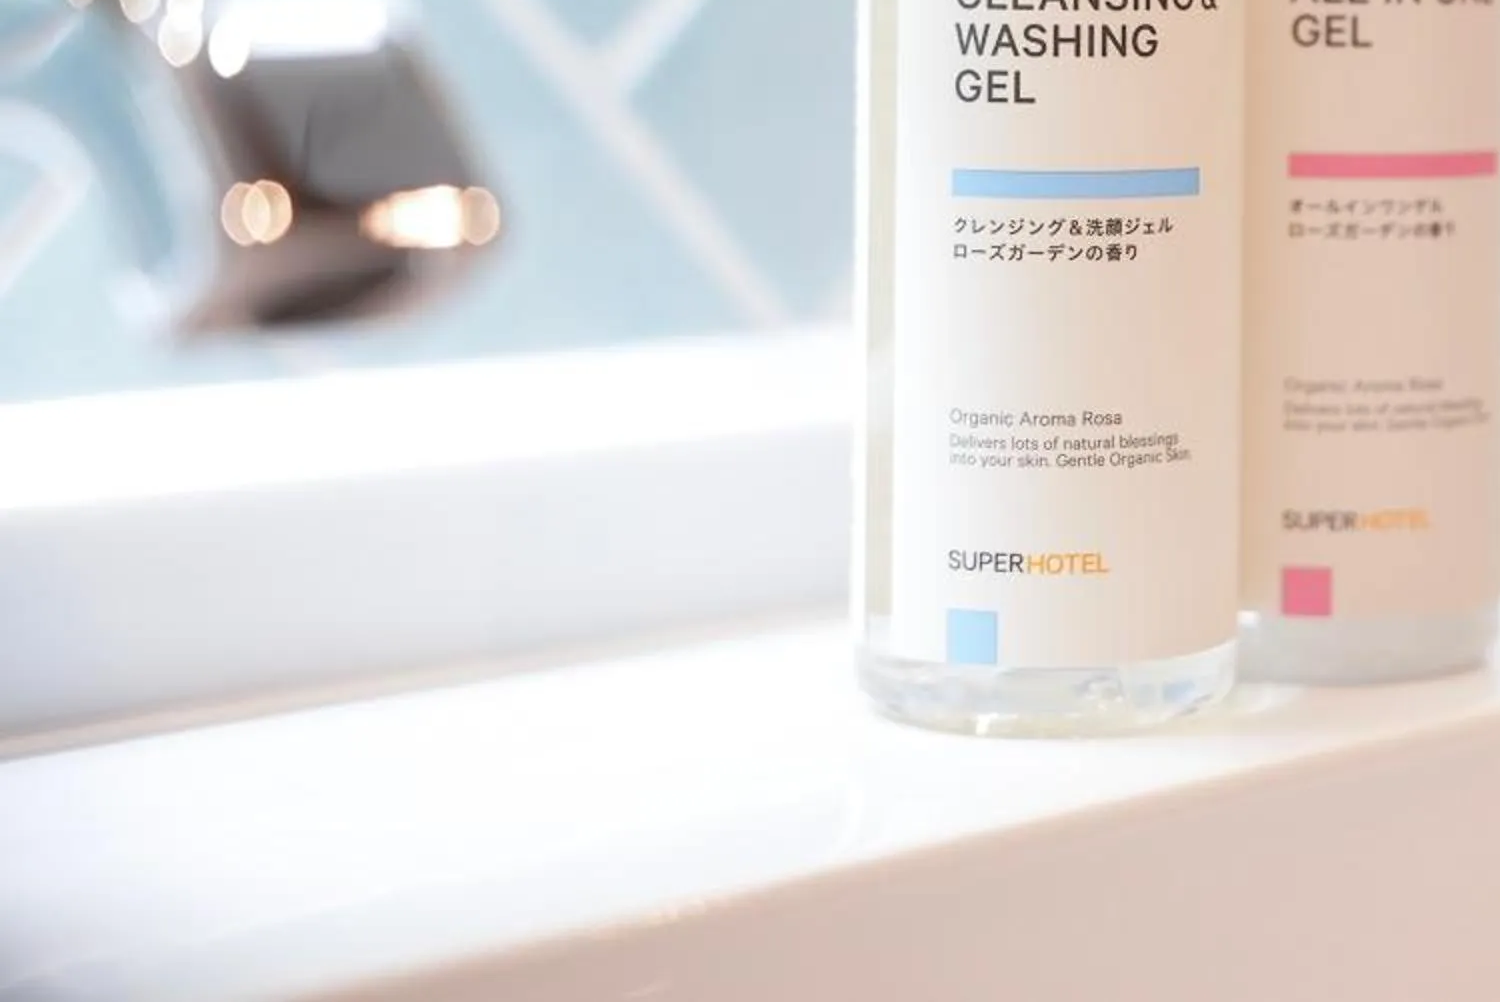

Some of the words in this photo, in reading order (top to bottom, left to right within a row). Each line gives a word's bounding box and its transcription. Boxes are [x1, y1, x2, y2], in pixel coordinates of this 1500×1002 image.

[955, 22, 1159, 58] WASHING
[1291, 13, 1373, 48] GEL
[955, 69, 1036, 104] GEL
[953, 243, 1138, 262] ローズガーデンの香り
[949, 407, 1014, 429] Organic
[1019, 410, 1076, 427] Aroma
[1081, 410, 1123, 426] Rosa
[1011, 436, 1039, 451] lots
[1043, 435, 1060, 451] of
[1063, 435, 1115, 451] natural
[980, 455, 1013, 469] your
[1055, 452, 1106, 468] Gentle
[1109, 452, 1163, 469] Organic
[1282, 509, 1430, 532] SUPER
